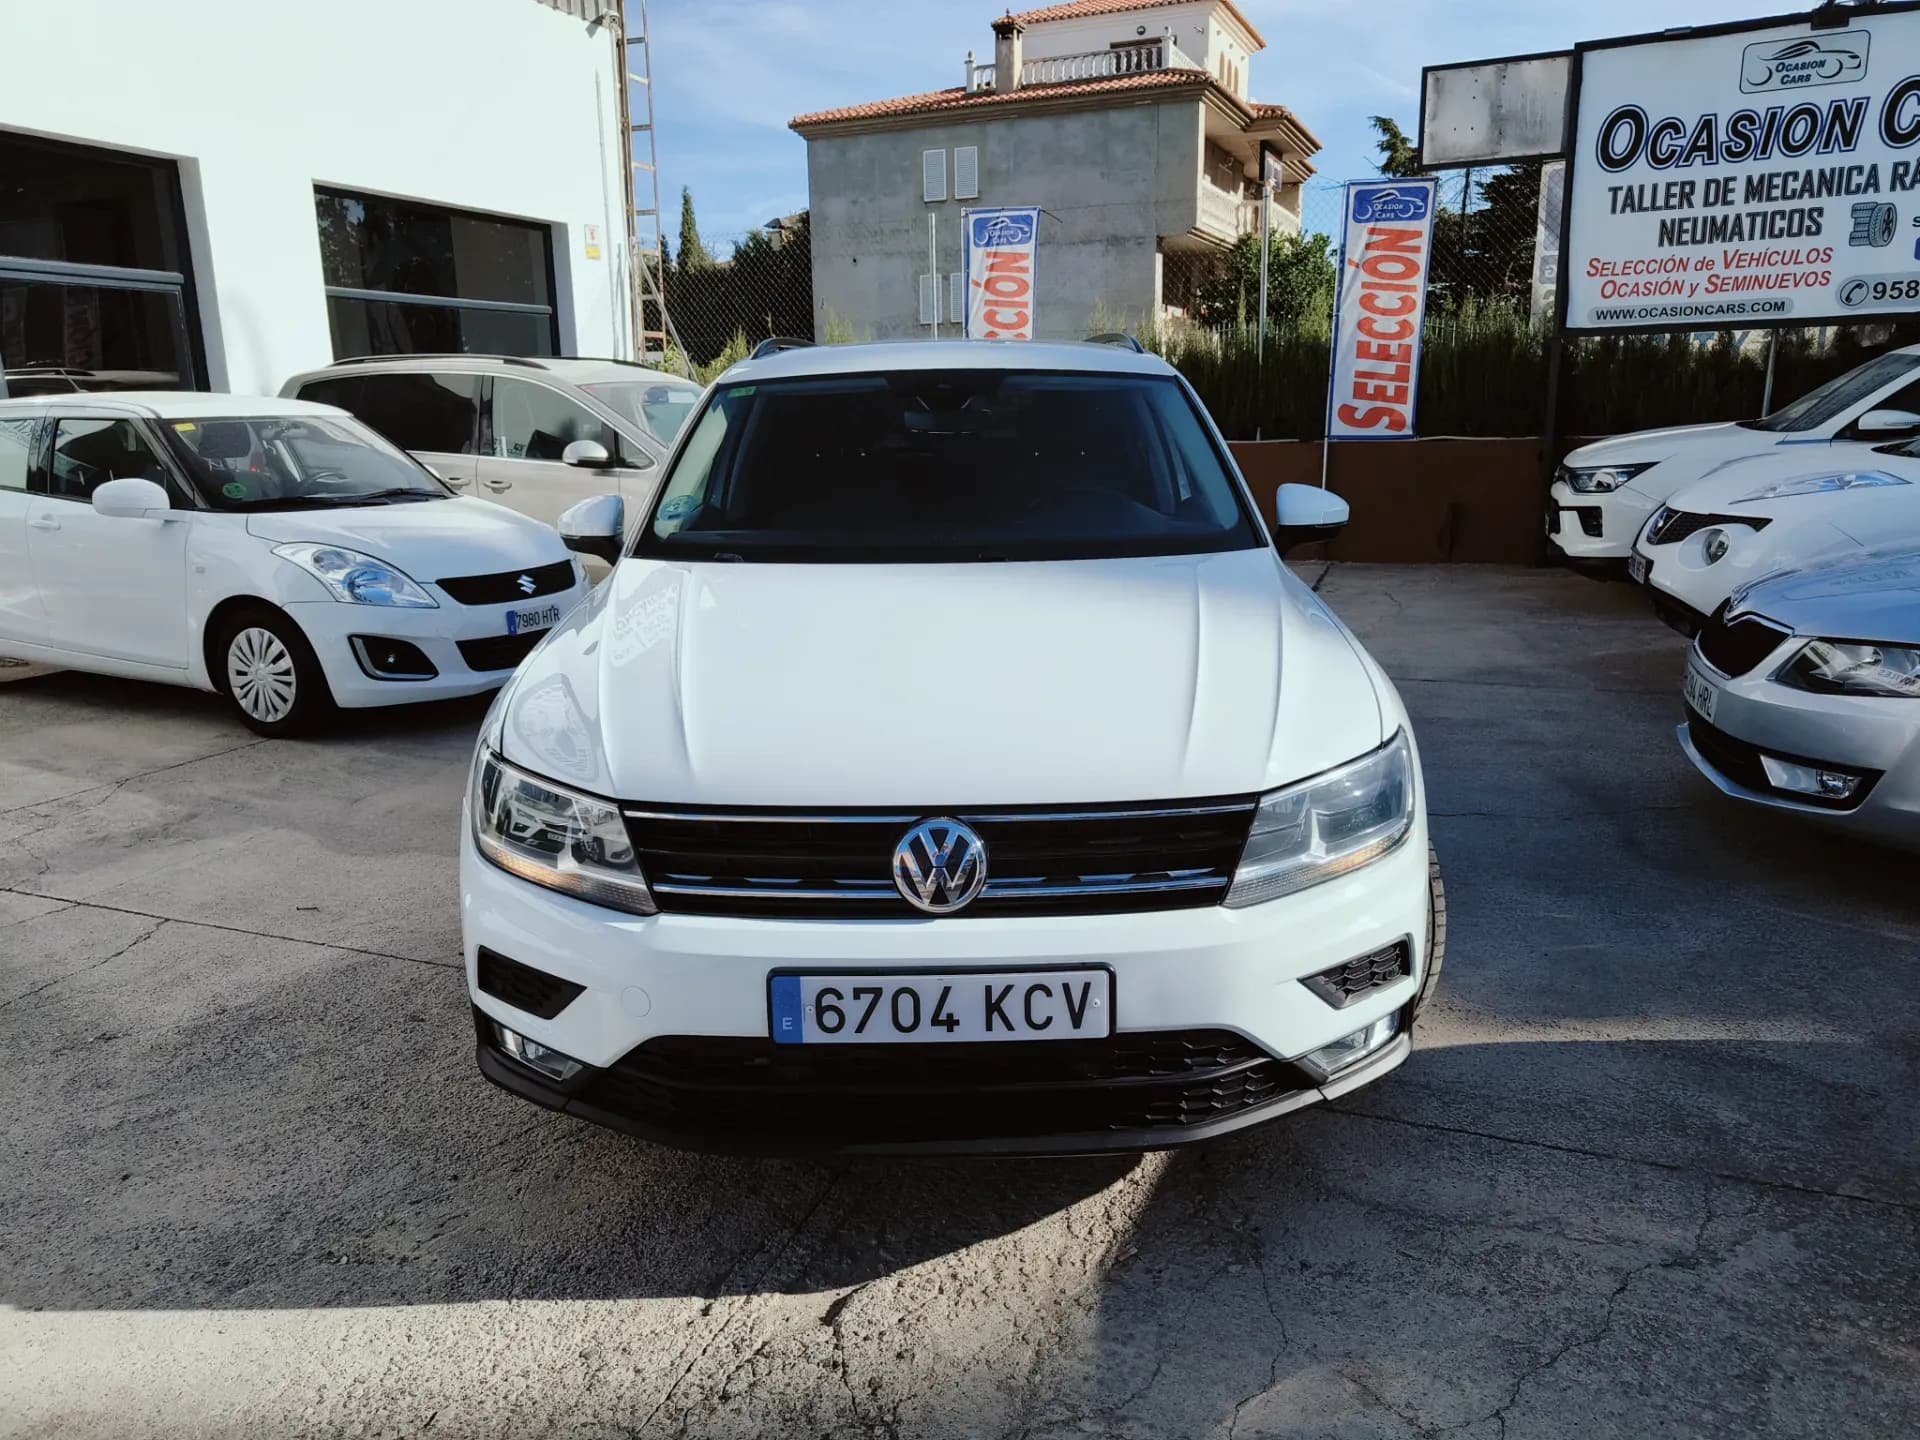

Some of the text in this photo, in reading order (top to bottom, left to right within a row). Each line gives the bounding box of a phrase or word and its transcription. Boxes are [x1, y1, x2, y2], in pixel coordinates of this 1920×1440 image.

[1775, 59, 1826, 73] OCASION
[1780, 74, 1811, 85] CARS
[1596, 96, 1871, 173] OCASION
[1608, 180, 1696, 214] TALLER
[1702, 176, 1737, 207] DE
[1744, 163, 1880, 204] MECANICA
[1658, 207, 1824, 248] NEUMATICOS
[1586, 246, 1833, 277] SELECCIÓN de VEHÍCULOS
[1600, 270, 1831, 299] OCASIÓN y SEMINUEVOS
[1596, 301, 1785, 320] WWW.OCASIONCARS.COM
[1337, 227, 1423, 432] SELECCIÓN
[516, 611, 539, 629] 7980
[815, 981, 1091, 1034] 6704 KCV
[782, 1017, 793, 1030] E
